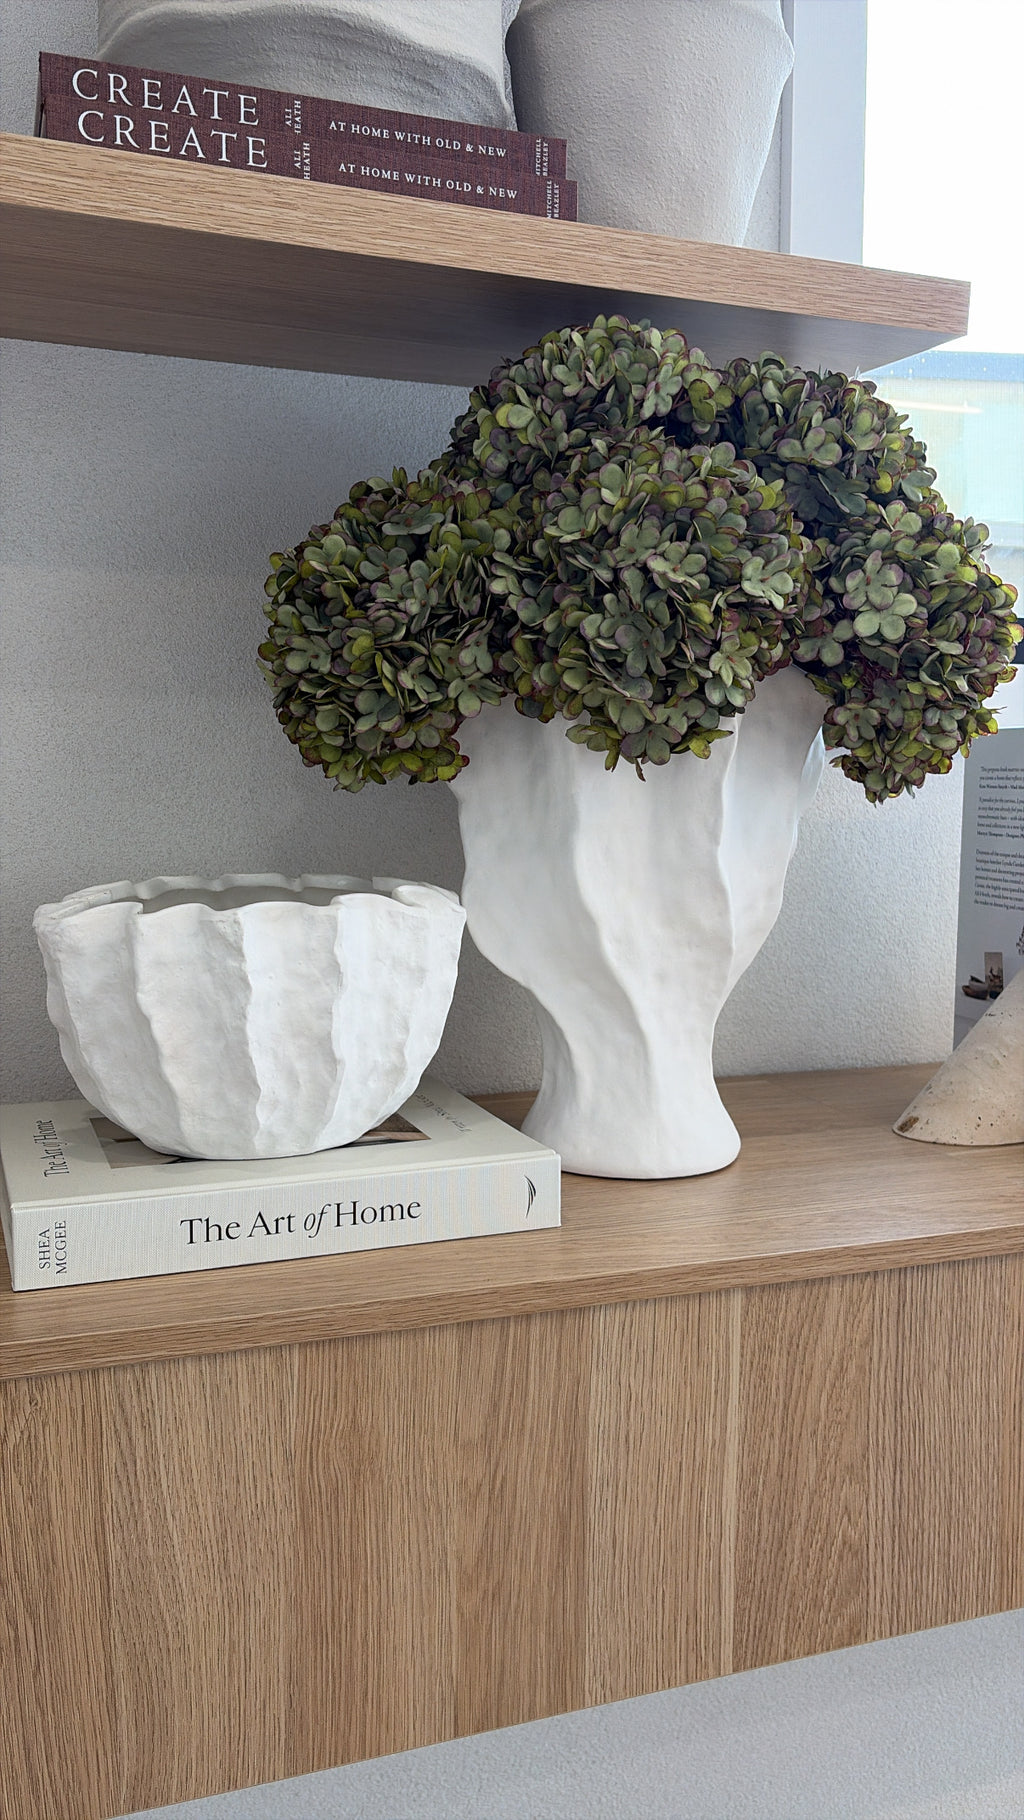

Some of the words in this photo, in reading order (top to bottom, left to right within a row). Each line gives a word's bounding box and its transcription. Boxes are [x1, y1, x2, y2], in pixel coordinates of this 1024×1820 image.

[72, 68, 259, 126] CREATE
[284, 108, 292, 127] ALI
[77, 110, 268, 168] CREATE
[329, 120, 346, 132] AT
[351, 124, 390, 139] HOME
[394, 131, 431, 146] WITH
[436, 138, 461, 150] OLD
[465, 143, 474, 152] &
[478, 145, 507, 158] NEW
[293, 150, 301, 169] ALI
[303, 142, 311, 180] HEATH
[338, 163, 356, 174] AT
[361, 166, 400, 181] HOME
[404, 173, 441, 188] WITH
[446, 180, 472, 192] OLD
[476, 185, 484, 194] &
[489, 187, 518, 199] NEW
[33, 1120, 58, 1141] Home
[40, 1148, 65, 1160] Art
[43, 1161, 70, 1177] The
[180, 1216, 241, 1245] The
[247, 1211, 296, 1239] Art
[303, 1203, 332, 1239] of
[333, 1200, 422, 1228] Home
[38, 1228, 51, 1270] SHEA
[55, 1220, 67, 1275] MCGEE
